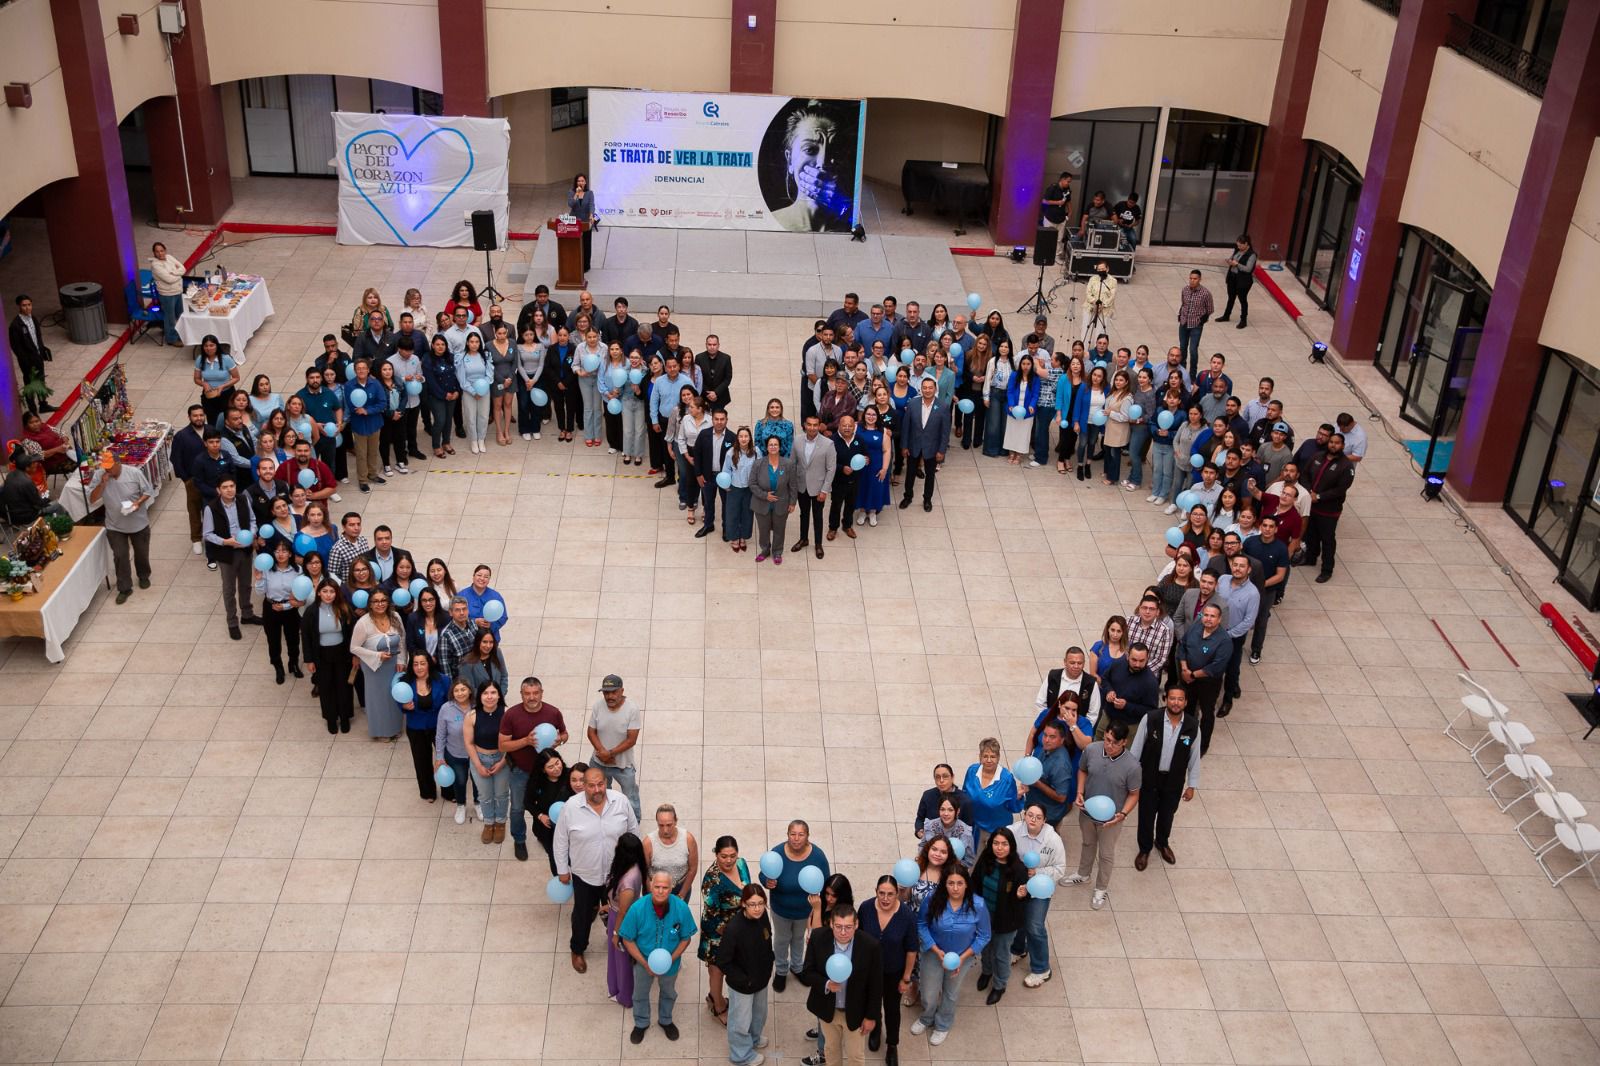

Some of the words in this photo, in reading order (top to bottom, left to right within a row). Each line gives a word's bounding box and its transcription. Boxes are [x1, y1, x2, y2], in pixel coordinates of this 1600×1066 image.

[353, 143, 398, 156] PACTO
[365, 155, 394, 167] DEL
[603, 148, 617, 163] SE
[620, 149, 655, 164] TRATA
[658, 150, 672, 165] DE
[676, 150, 697, 165] VER
[701, 151, 714, 166] LA
[717, 152, 751, 167] TRATA
[354, 168, 423, 183] CORAZON
[654, 175, 705, 184] ¡DENUNCIA!
[378, 182, 418, 194] AZUL
